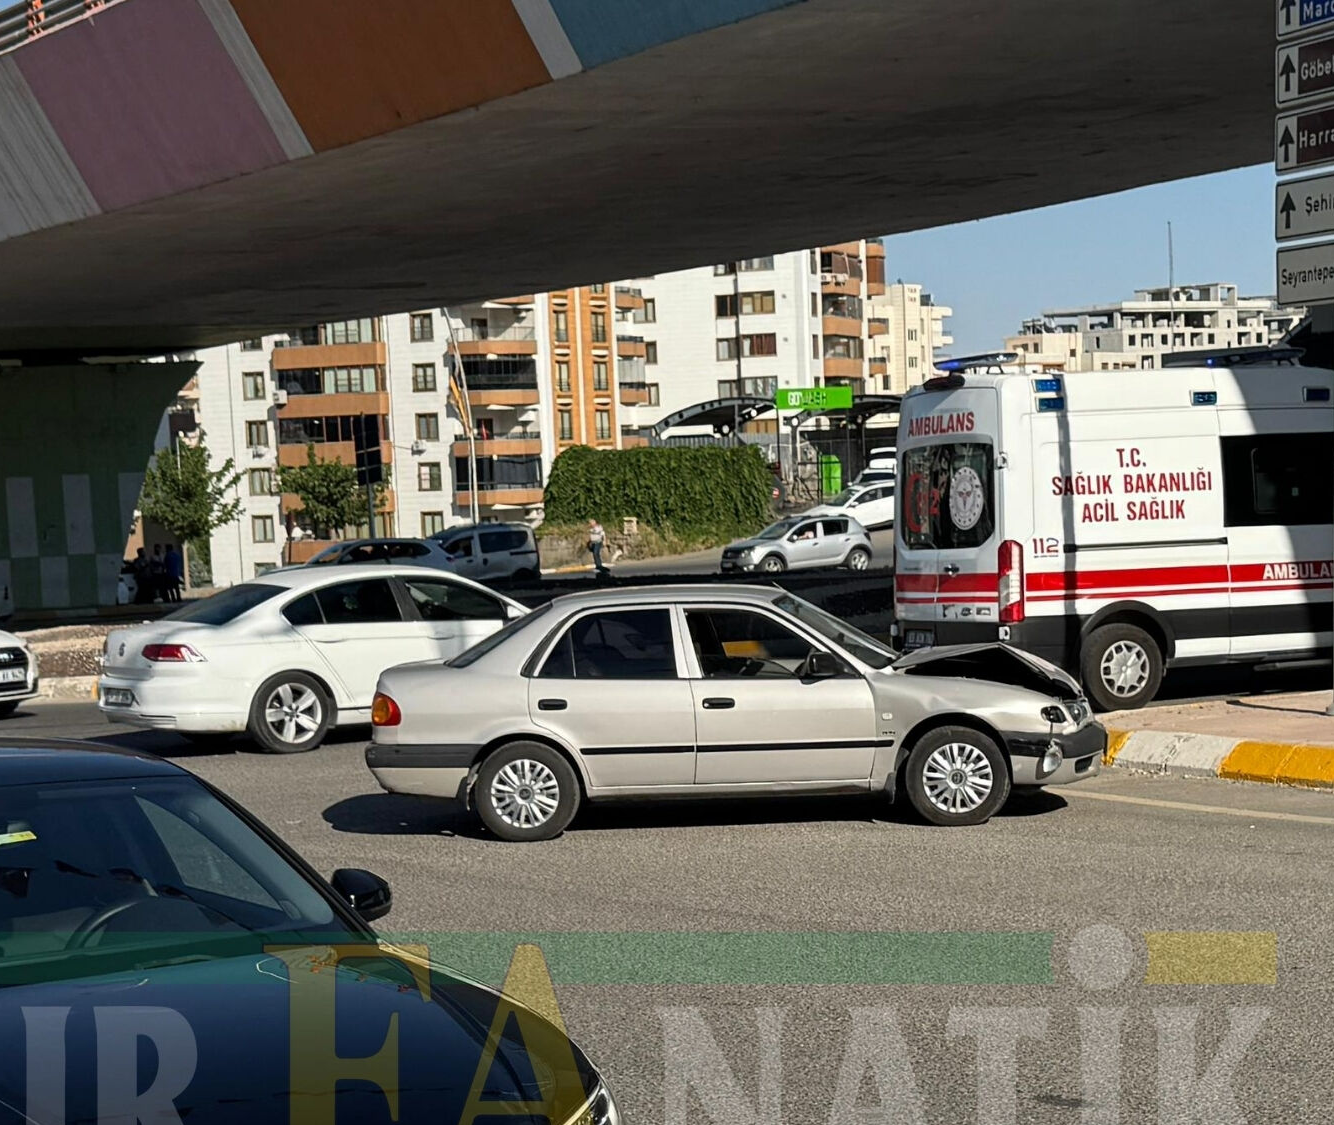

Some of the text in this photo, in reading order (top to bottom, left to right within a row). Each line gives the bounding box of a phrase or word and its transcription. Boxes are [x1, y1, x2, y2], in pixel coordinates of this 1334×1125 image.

[908, 411, 975, 438] AMBULANS
[1116, 447, 1147, 468] T.C.
[1051, 467, 1212, 496] SAĞLIK BAKANLIĞI
[1082, 496, 1186, 523] ACİL SAĞLIK
[1032, 537, 1059, 554] 112
[1262, 562, 1334, 580] AMBULA
